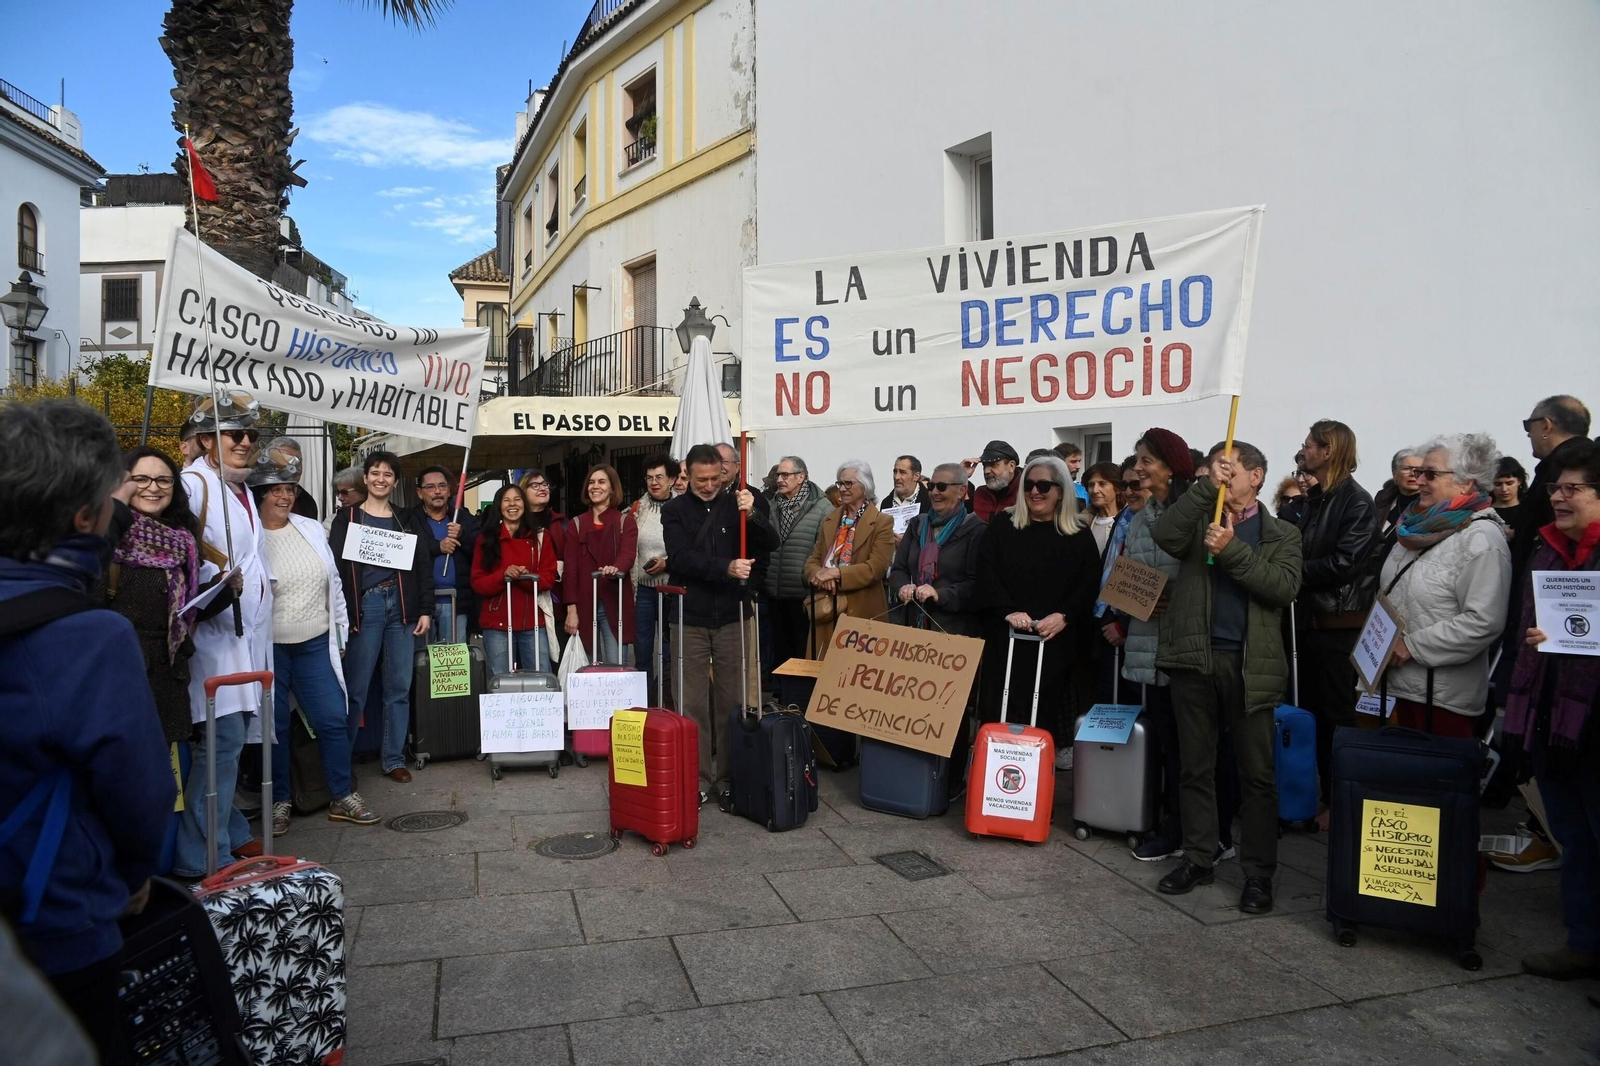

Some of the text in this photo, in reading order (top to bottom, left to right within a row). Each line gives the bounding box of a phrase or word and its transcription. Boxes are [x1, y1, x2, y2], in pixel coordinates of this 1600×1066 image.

[815, 266, 868, 305] LA
[178, 288, 280, 352] CASCO
[774, 274, 1213, 363] ES un DERECHO
[774, 370, 831, 417] NO
[874, 384, 916, 412] un
[513, 412, 536, 430] EL
[542, 413, 611, 432] PASEO
[619, 414, 653, 432] DEL
[362, 527, 403, 541] QUEREMOS
[359, 544, 375, 552] NO
[360, 538, 404, 551] CASCO VIVO
[359, 549, 386, 559] PARQUE
[835, 629, 967, 672] CASCO HISTÓRICO
[438, 657, 463, 666] VIVO
[434, 670, 468, 678] VIVIENDAS
[569, 676, 636, 689] NO AL TURISMO
[587, 689, 623, 697] MASIVO
[485, 706, 563, 718] PISOS PARA TURISTAS
[816, 693, 841, 716] DE
[844, 703, 945, 740] EXTINCIÓN
[506, 718, 545, 727] SE VENDE
[616, 723, 641, 733] TURISMO
[517, 729, 528, 739] DEL
[532, 729, 560, 739] BARRIO
[617, 733, 642, 741] MASIVO
[1005, 749, 1033, 757] VIVIENDAS
[988, 802, 1029, 812] VACACIONALES
[1374, 807, 1389, 817] EN
[1371, 816, 1408, 831] CASCO
[1370, 828, 1433, 844] HISTORICO
[1375, 845, 1434, 858] NECESITAN
[1375, 854, 1434, 869] VIVIENDAS
[1363, 877, 1414, 890] VIMCORSA
[1365, 884, 1423, 902] ACTUA YA
